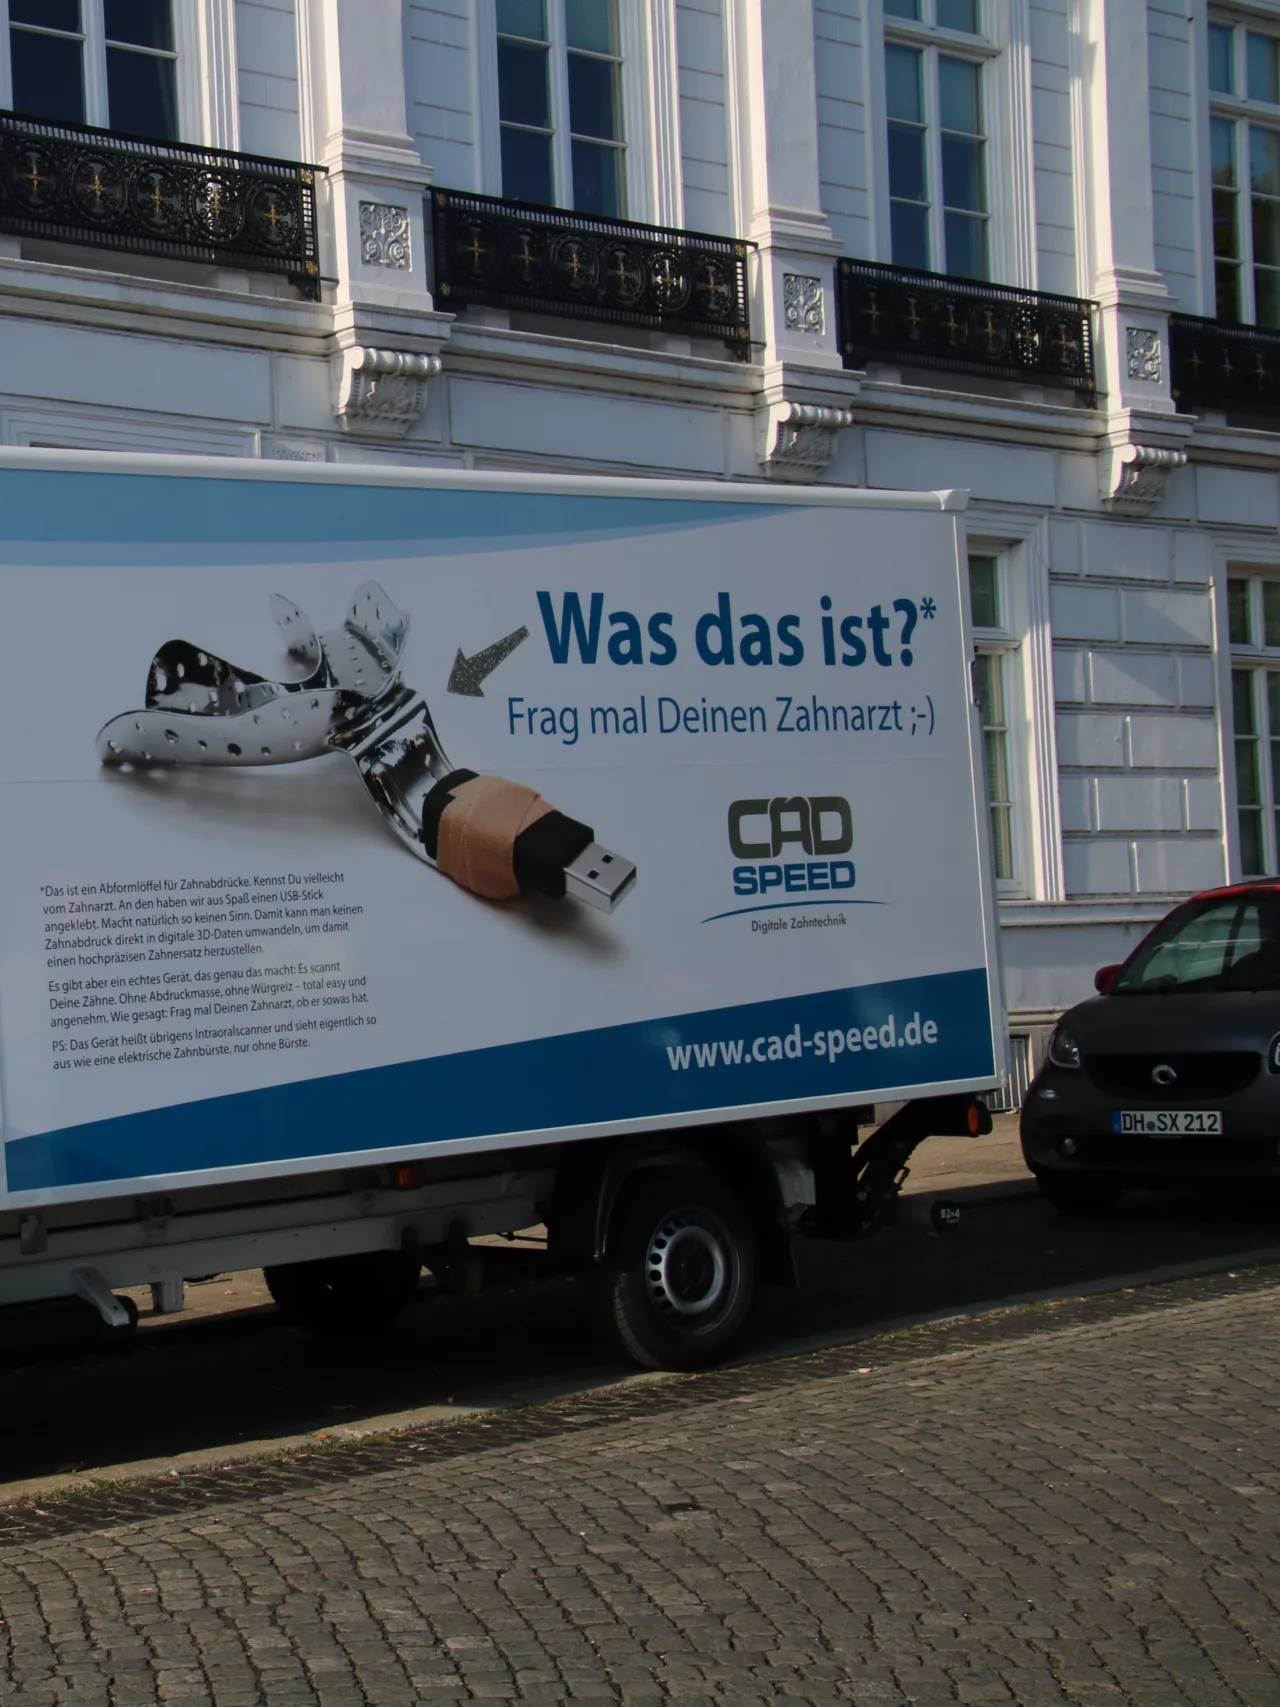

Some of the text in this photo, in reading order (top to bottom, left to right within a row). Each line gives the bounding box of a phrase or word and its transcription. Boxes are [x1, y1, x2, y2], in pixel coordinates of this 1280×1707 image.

[536, 591, 677, 666] Was
[695, 592, 804, 667] das
[508, 697, 578, 745] Frag
[591, 696, 647, 734] mal
[658, 697, 767, 734] Deinen
[776, 695, 902, 732] Zahnarzt
[728, 796, 853, 859] CAD
[66, 884, 79, 895] ist
[80, 884, 97, 895] ein
[98, 880, 162, 893] Abformlöffel
[163, 879, 178, 890] für
[179, 876, 252, 889] Zahnabdrücke.
[253, 875, 286, 886] Kennst
[287, 873, 302, 884] Du
[302, 872, 344, 883] vielleicht
[733, 861, 856, 895] SPEED
[42, 889, 323, 914] vom Zahnarzt. An den haben wir aus Spaß einen USB-Stick
[44, 904, 363, 934] angeklebt. Macht natürlich so keinen Sinn. Damit kann man keinen
[751, 913, 847, 934] Digitale Zahntechnik
[44, 921, 348, 949] Zahnabdruck direkt in digitale 3D-Daten umwandeln, um damit
[46, 943, 264, 967] einen hochpräzisen Zahnersatz herzustellen.
[48, 962, 340, 993] Es gibt aber ein echtes Gerät, das genau das macht: Es scannt
[49, 997, 80, 1009] Deine
[81, 995, 117, 1007] Zähne.
[118, 992, 147, 1004] Ohne
[148, 988, 223, 1001] Abdruckmasse,
[224, 984, 249, 996] ohne
[250, 981, 293, 995] Würgreiz
[302, 978, 324, 990] total
[325, 979, 346, 989] easy
[347, 975, 366, 986] und
[50, 992, 368, 1029] angenehm. Wie gesagt: Frag mal Deinen Zahnarzt, ob er sowas hat.
[51, 1015, 376, 1051] PS: Das Gerät heißt übrigens Intraoralscanner und sieht eigentlich so
[666, 1012, 938, 1070] www.cad-speed.de
[53, 1038, 310, 1069] aus wie eine elektrische Zahnbürste, nur ohne Bürste.
[1122, 1113, 1219, 1132] DH SX 212
